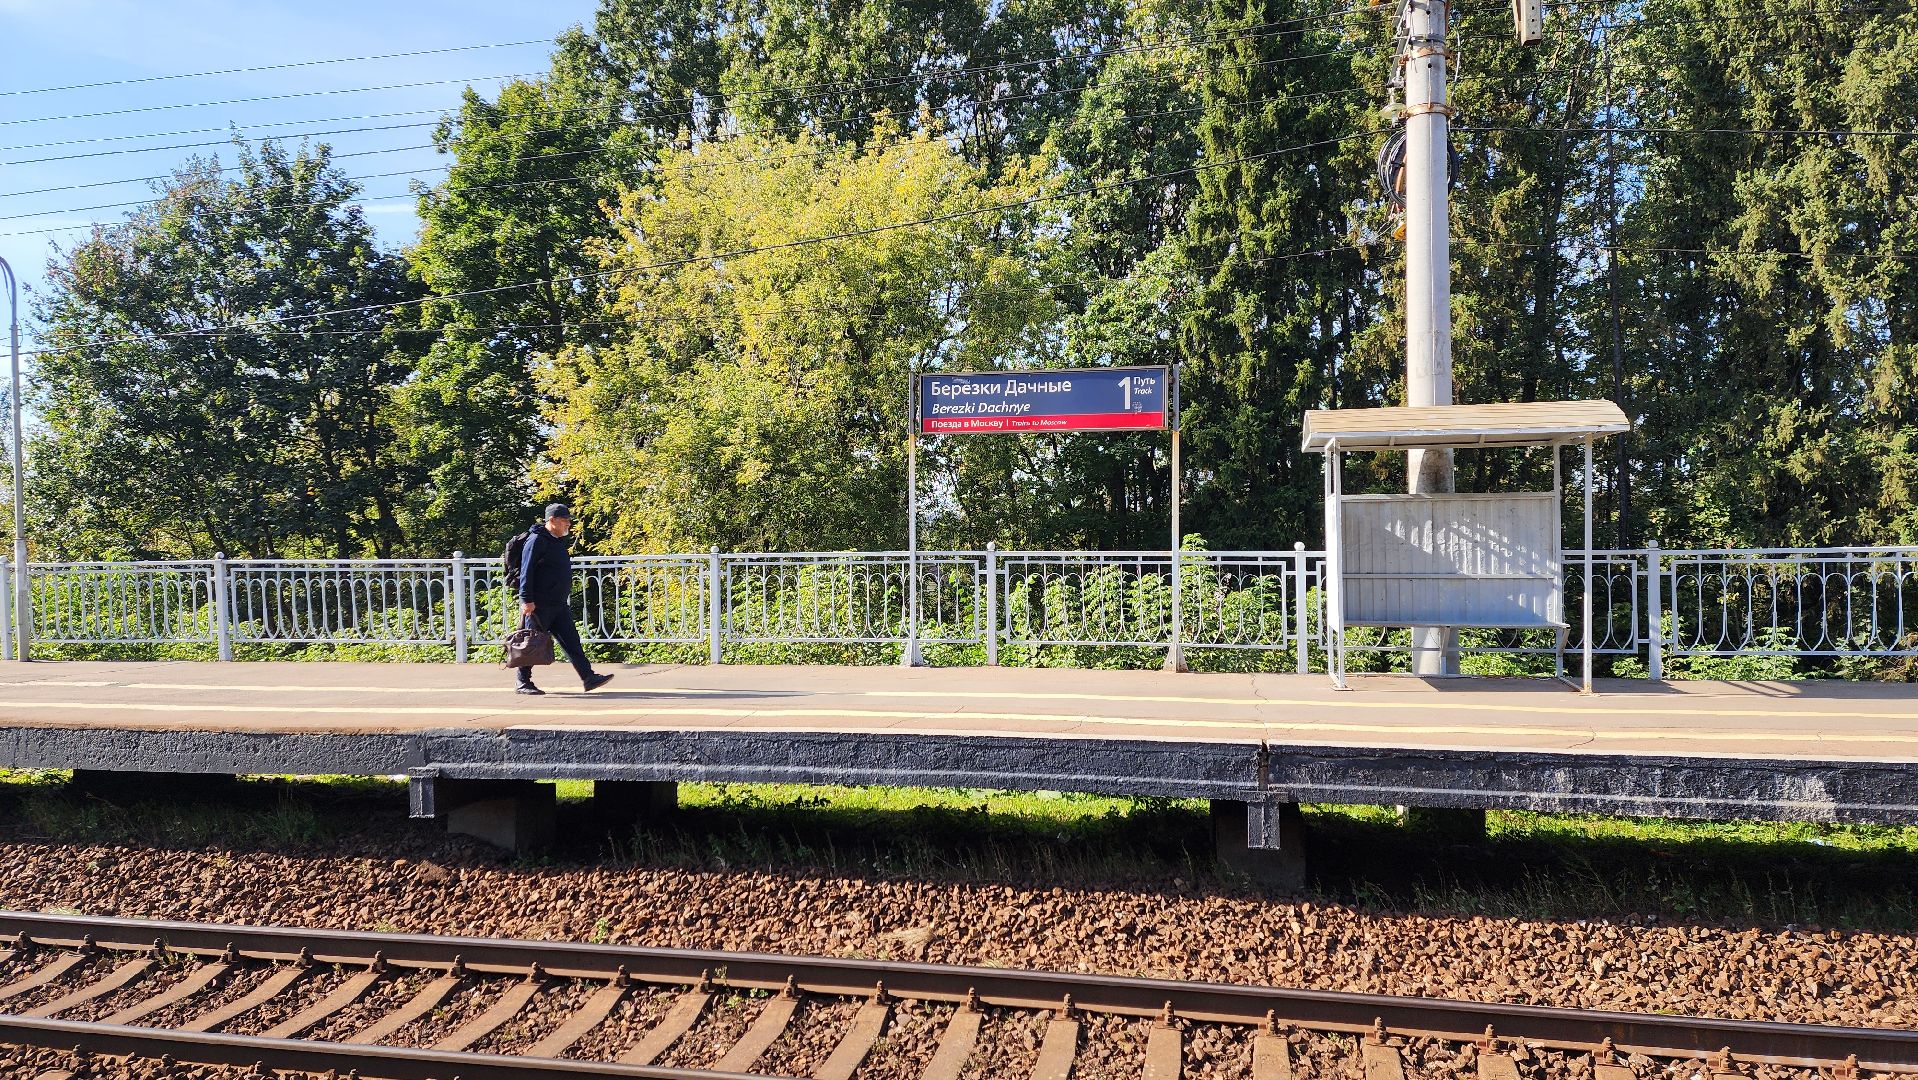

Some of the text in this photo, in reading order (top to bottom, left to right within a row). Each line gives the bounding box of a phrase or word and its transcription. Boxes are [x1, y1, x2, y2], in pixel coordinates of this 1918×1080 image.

[1004, 379, 1071, 396] Дачные
[1133, 376, 1155, 387] Путь
[1117, 376, 1131, 410] 1
[931, 401, 1031, 416] Berezki Dachnye
[931, 420, 961, 428] Поезда
[970, 419, 1004, 429] Москву
